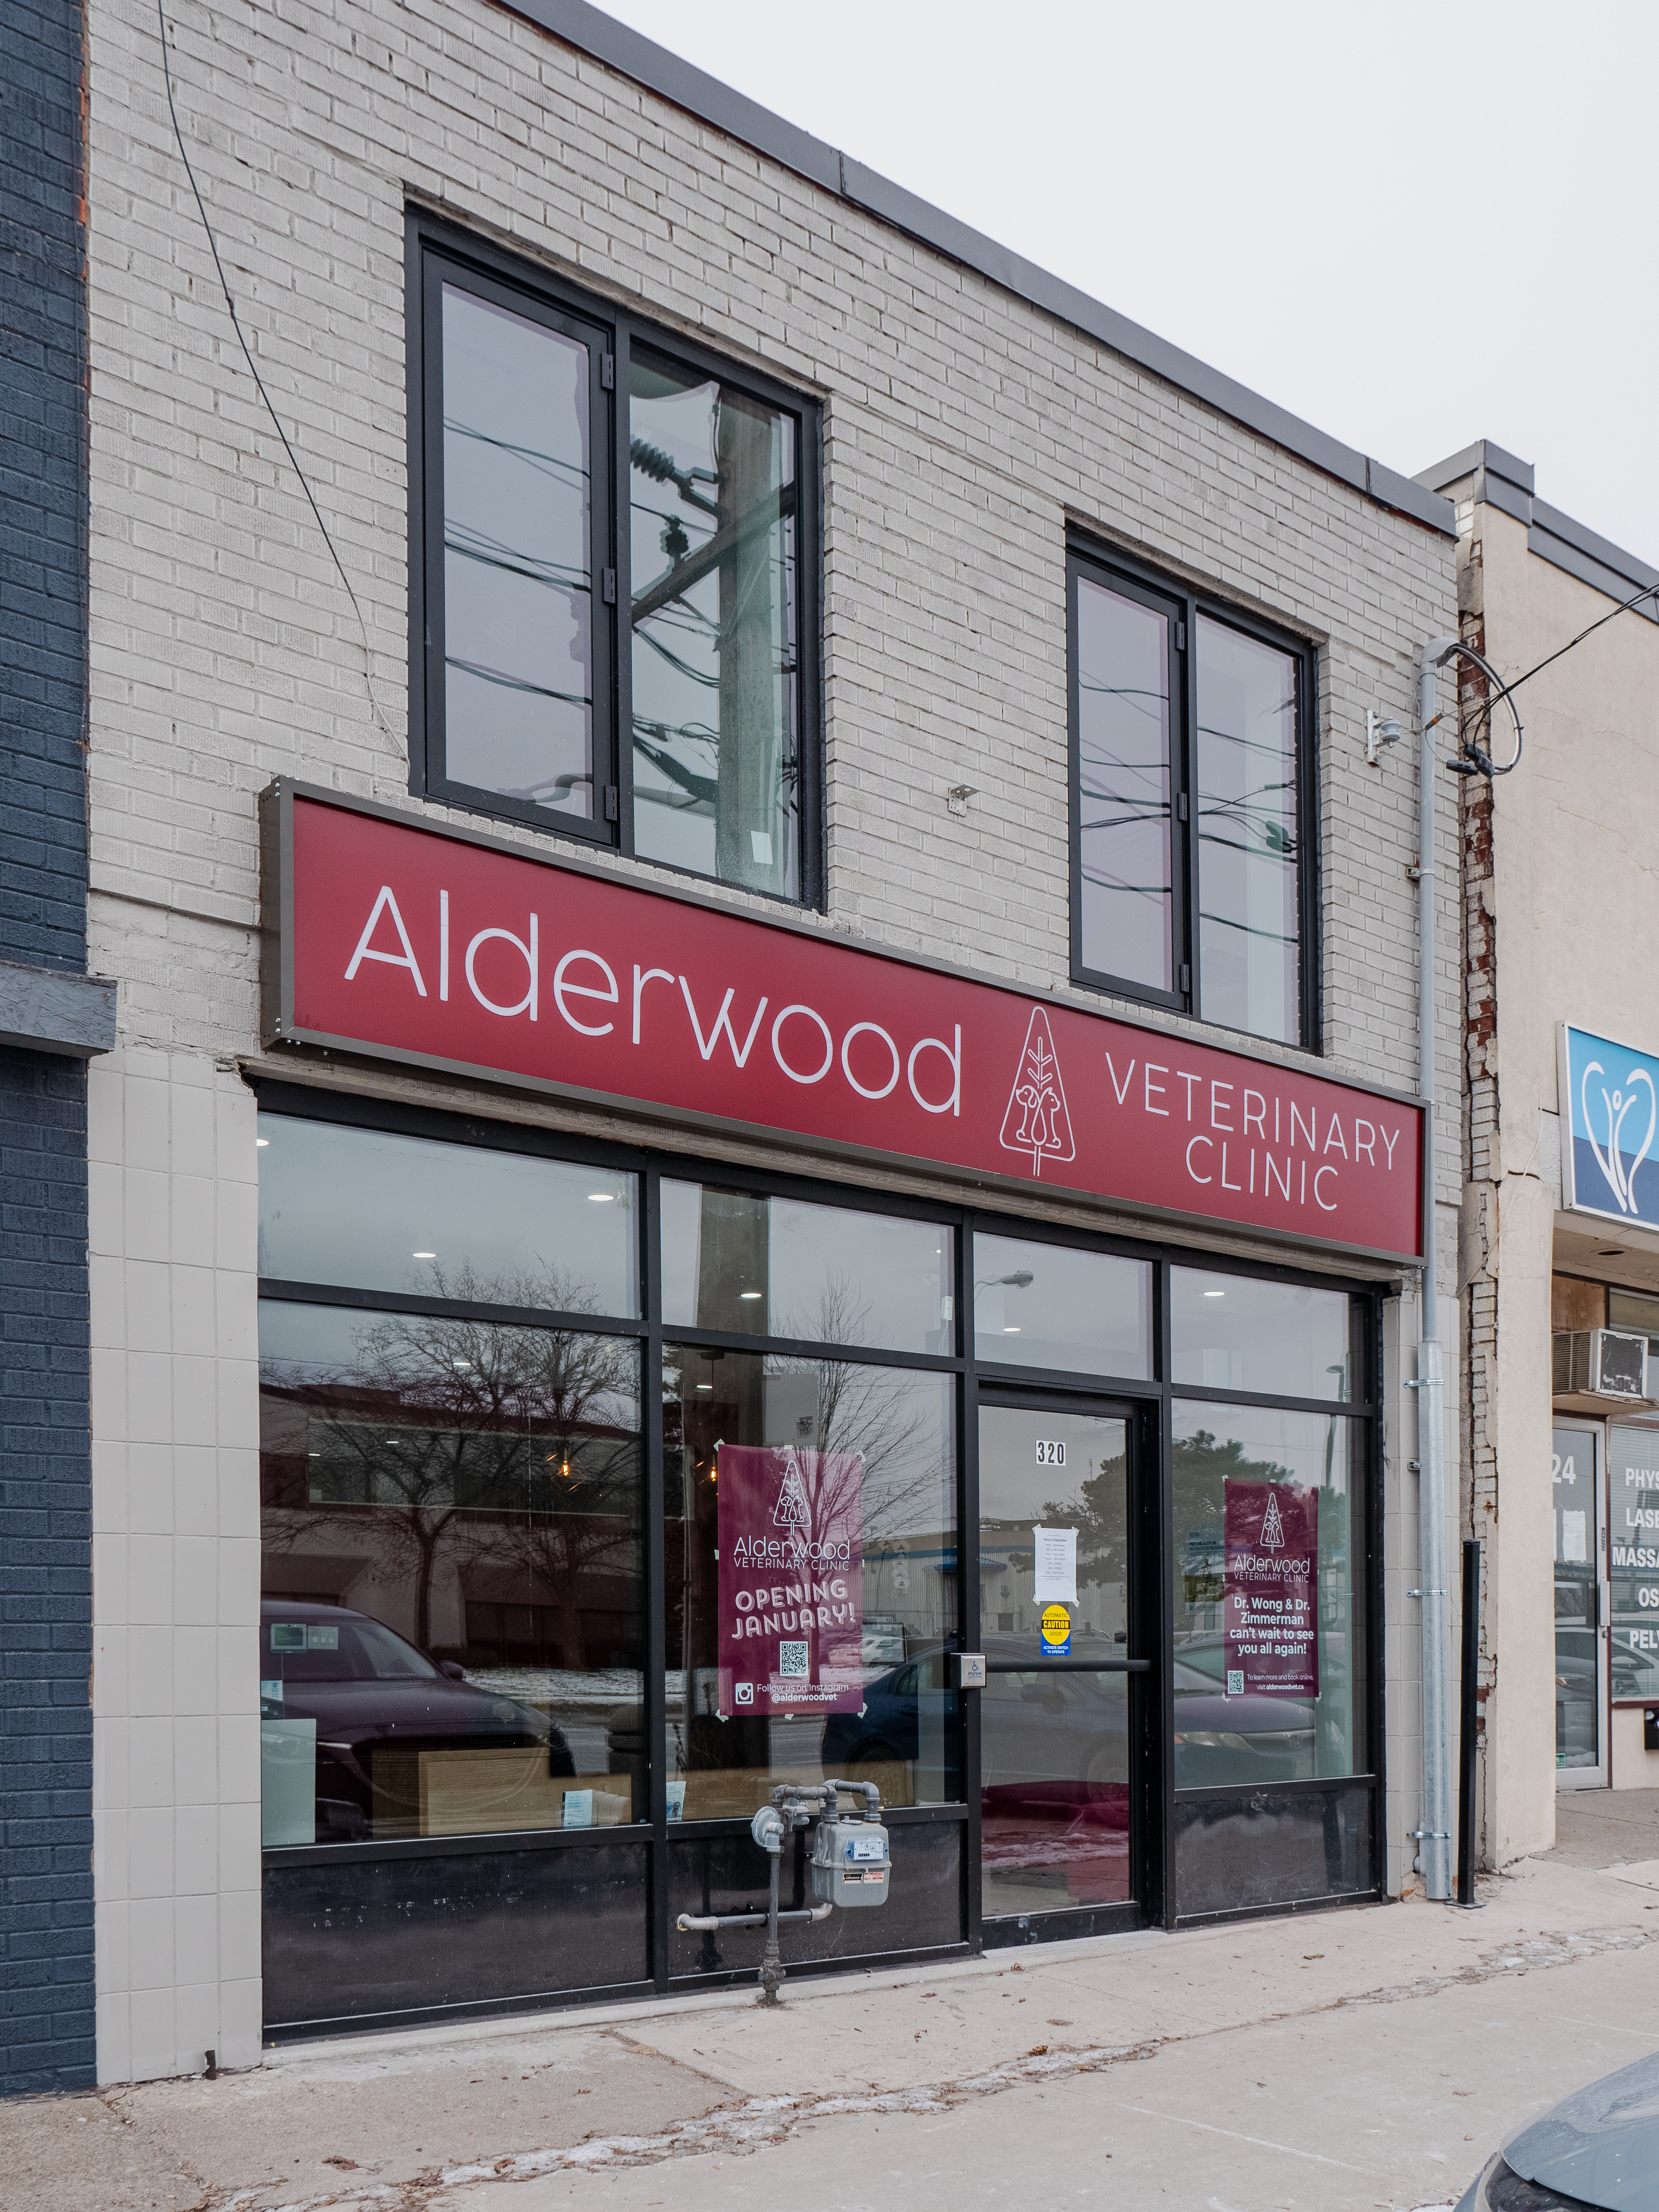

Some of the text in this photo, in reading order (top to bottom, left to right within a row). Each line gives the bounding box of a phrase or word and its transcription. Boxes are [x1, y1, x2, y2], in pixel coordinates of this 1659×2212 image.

[345, 885, 961, 1118] Alderwood
[1105, 1052, 1400, 1171] VETERINARY
[1185, 1135, 1339, 1211] CLINIC
[1038, 1442, 1064, 1464] 320
[734, 1535, 850, 1560] Alderwood
[734, 1557, 849, 1571] VETERINARY CLINIC
[1234, 1553, 1310, 1574] Alderwood
[1234, 1571, 1310, 1583] VETERINARY CLINIC
[735, 1578, 848, 1612] OPENING
[1234, 1596, 1249, 1609] Dr.
[1251, 1597, 1283, 1612] Wong
[1285, 1598, 1293, 1610] &
[1295, 1599, 1310, 1611] Dr.
[731, 1602, 856, 1640] JANUARY!
[1043, 1620, 1069, 1629] CAUTION
[1240, 1611, 1304, 1625] Zimmerman
[1229, 1626, 1314, 1640] can't wait to see
[1237, 1641, 1307, 1657] you all again!
[757, 1684, 784, 1692] Follow
[809, 1684, 849, 1694] Instagram
[771, 1692, 837, 1703] @alderwoodvet
